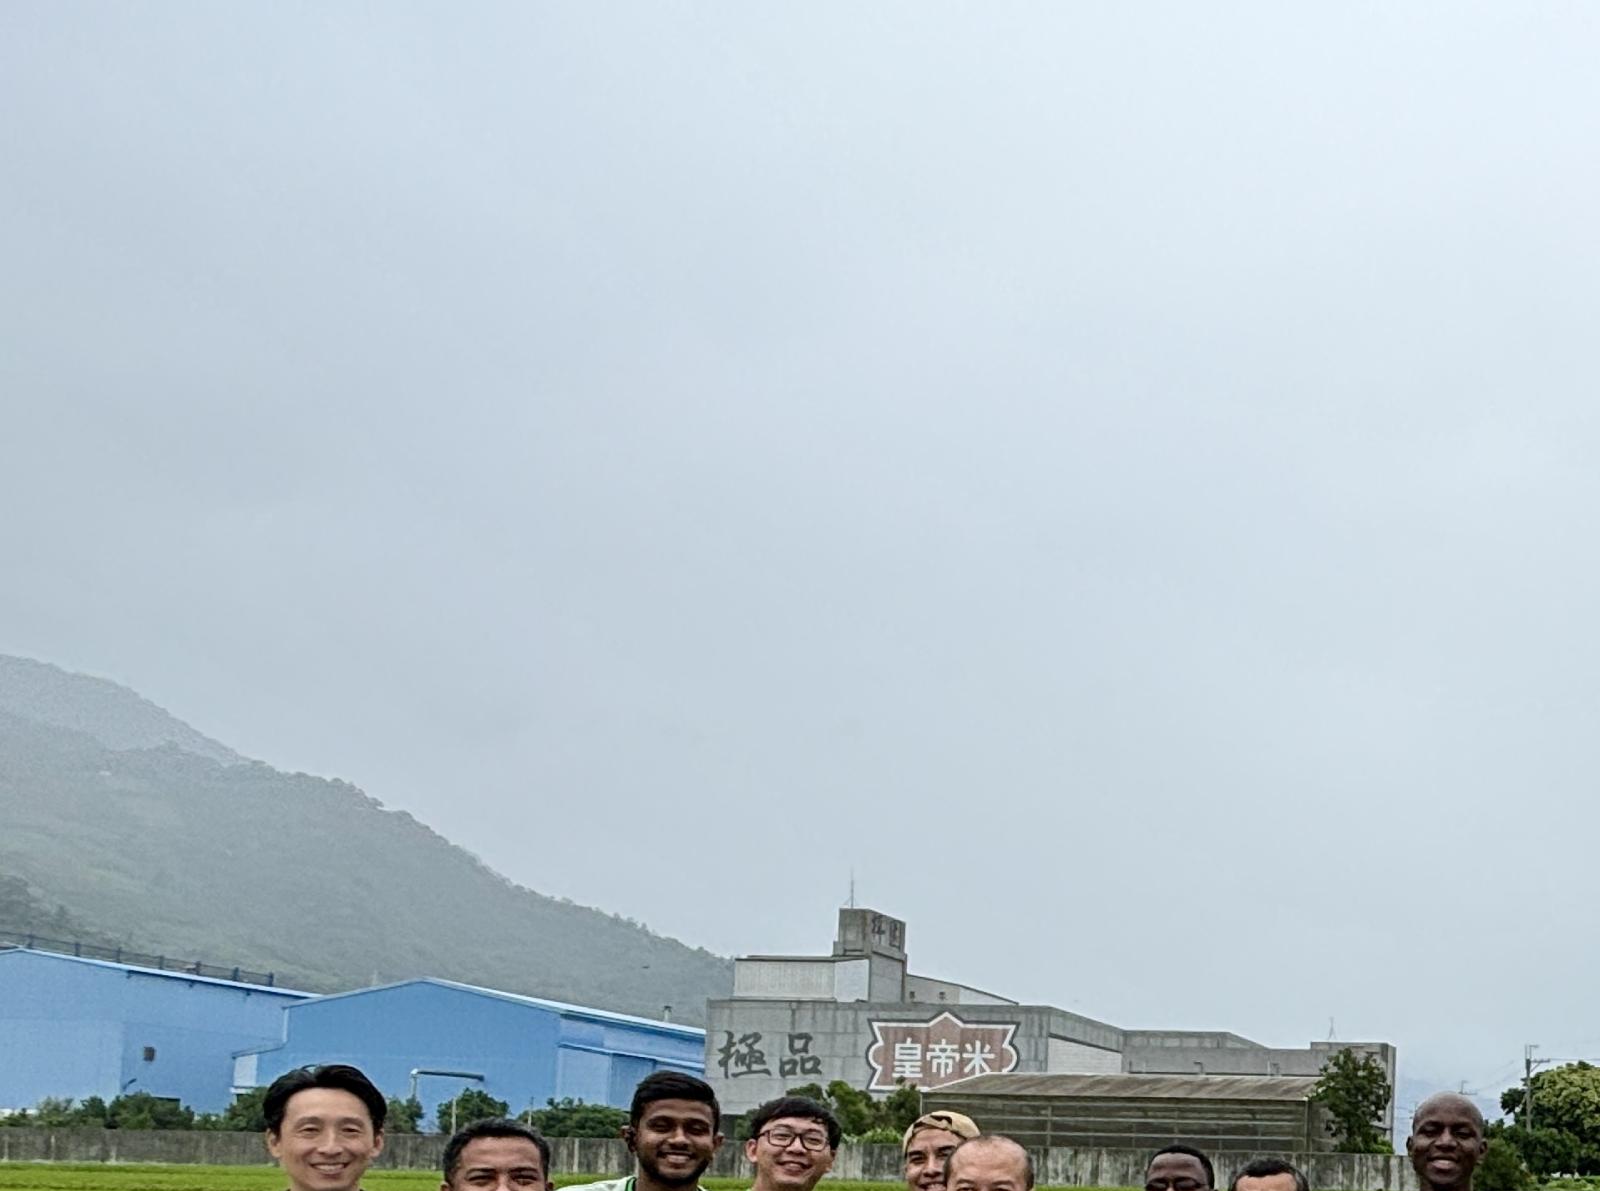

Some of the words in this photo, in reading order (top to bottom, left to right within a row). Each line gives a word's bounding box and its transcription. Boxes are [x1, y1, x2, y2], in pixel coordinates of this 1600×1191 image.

[718, 1030, 823, 1079] 極品
[892, 1037, 996, 1078] 皇帝米
